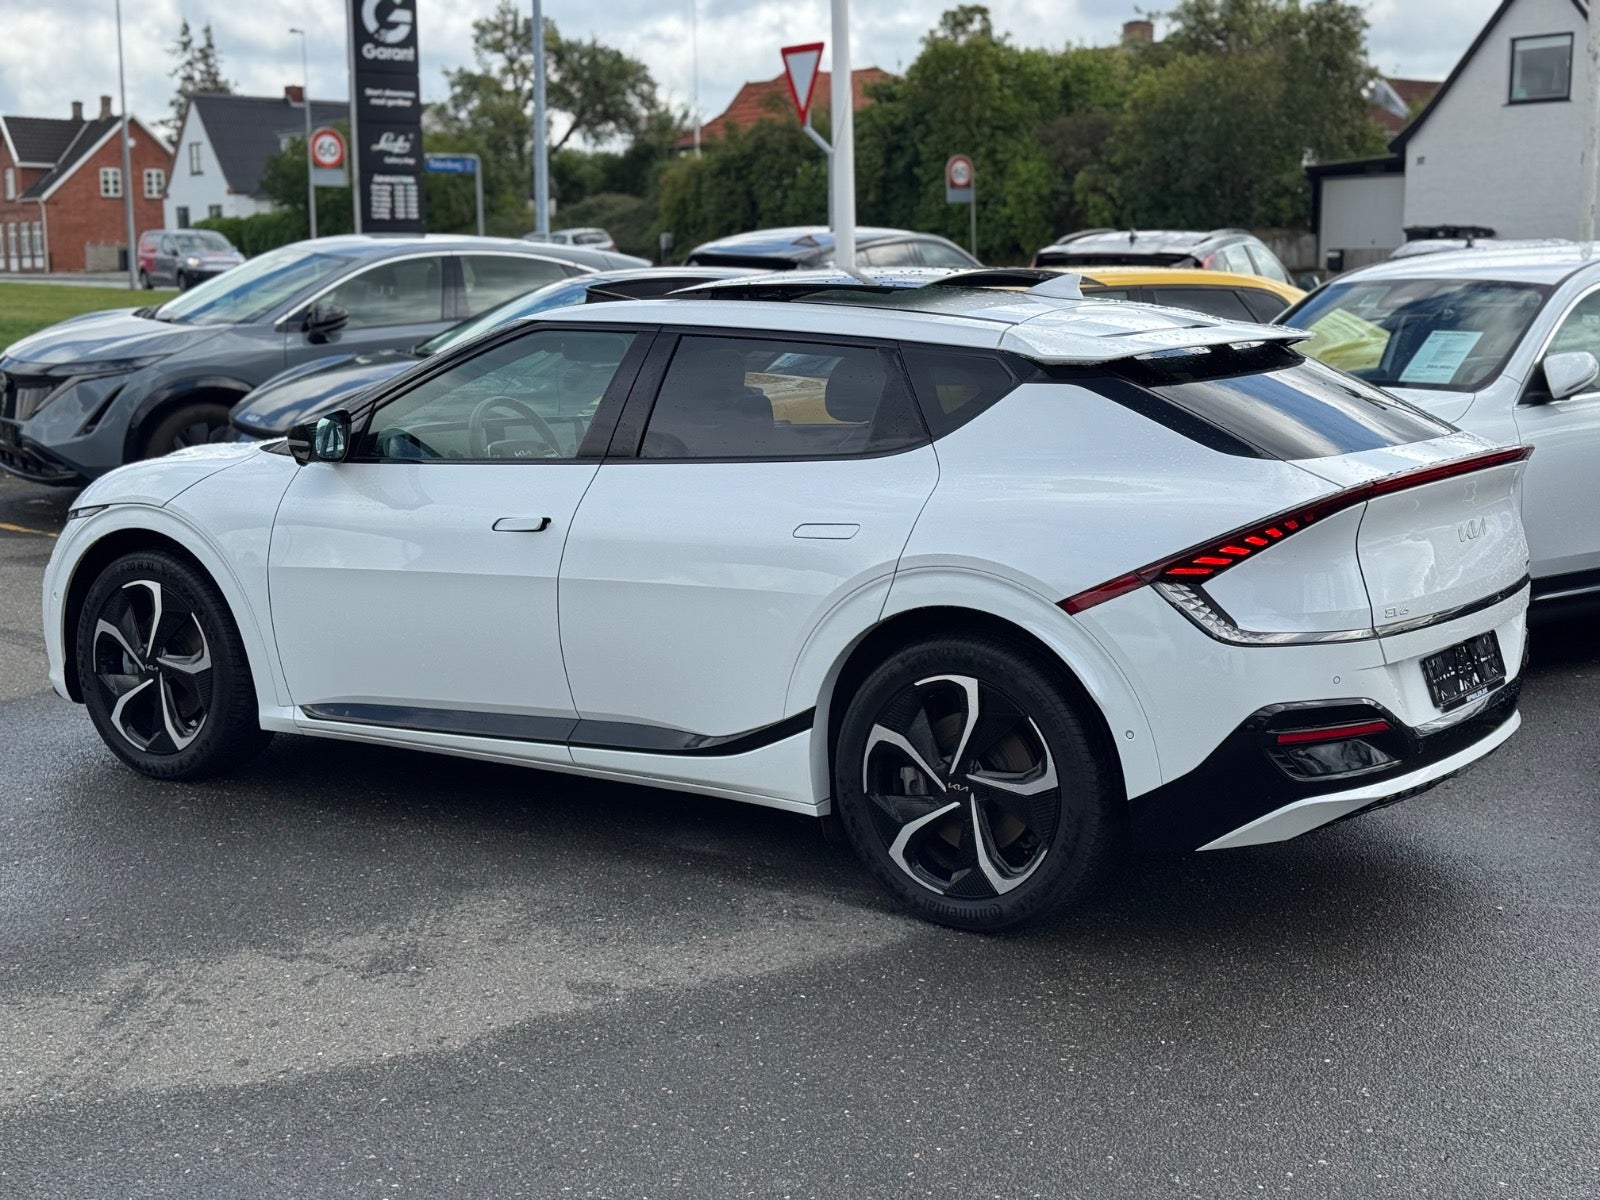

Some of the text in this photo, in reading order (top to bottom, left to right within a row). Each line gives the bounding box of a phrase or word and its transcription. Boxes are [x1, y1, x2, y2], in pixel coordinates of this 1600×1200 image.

[317, 141, 338, 158] 60
[1457, 516, 1487, 543] KIA
[947, 782, 969, 792] KIA
